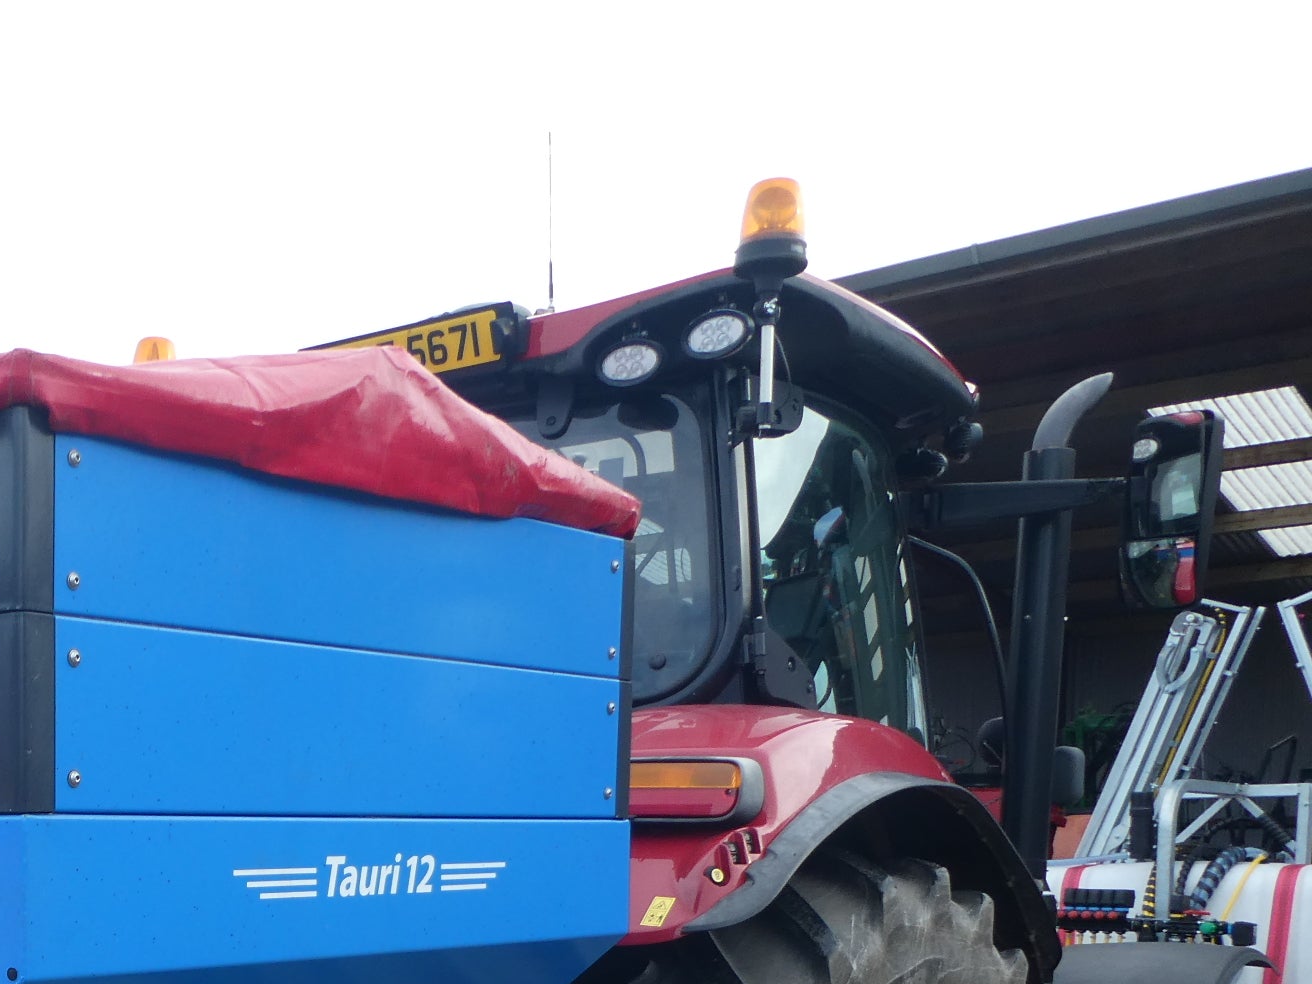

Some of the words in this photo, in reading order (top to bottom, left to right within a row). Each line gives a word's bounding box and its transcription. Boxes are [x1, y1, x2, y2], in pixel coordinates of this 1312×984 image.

[407, 321, 480, 366] 5671
[325, 853, 403, 897] Tauri
[406, 854, 436, 894] 12
